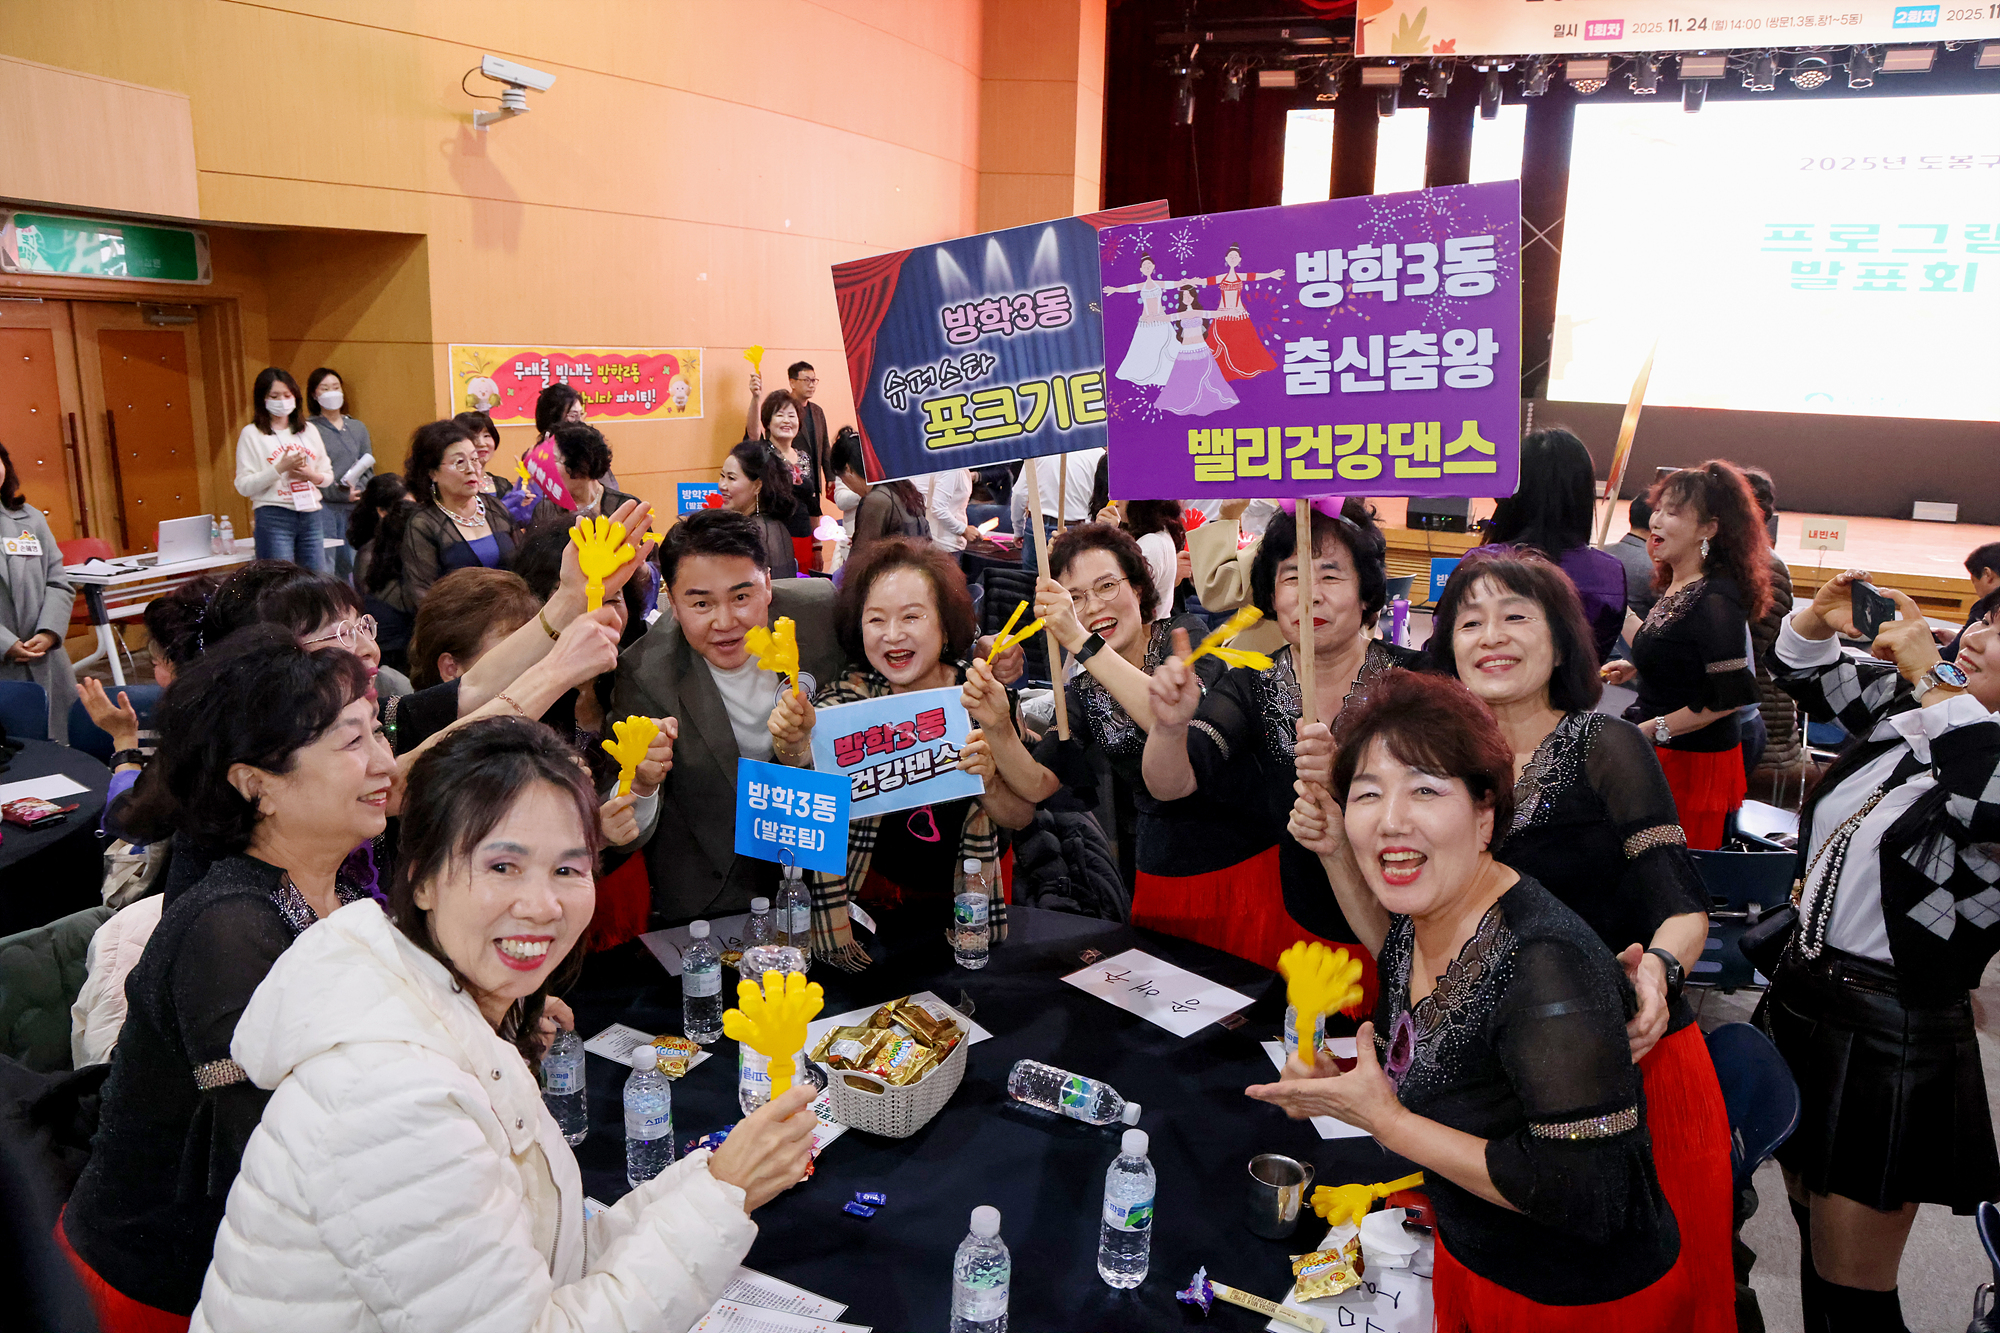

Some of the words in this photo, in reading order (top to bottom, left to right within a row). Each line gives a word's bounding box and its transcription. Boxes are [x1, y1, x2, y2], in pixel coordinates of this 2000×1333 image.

[1553, 23, 1578, 38] 일시
[1586, 22, 1621, 38] 1회차
[1632, 22, 1665, 34] 2025.
[1730, 18, 1761, 31] 14:00
[1895, 10, 1937, 24] 2회차
[1946, 9, 1985, 22] 2025.
[1799, 156, 1907, 171] 2025년
[1917, 154, 2000, 170] 도봉구
[1295, 235, 1498, 308] 방학3동
[1790, 260, 1979, 292] 발표회
[942, 286, 1072, 344] 방학3동
[514, 358, 551, 388] 무대를
[1283, 328, 1499, 395] 춤신춤왕
[616, 388, 657, 409] 파이팅!
[884, 353, 995, 410] 슈퍼스타
[1188, 420, 1497, 481] 밸리건강댄스
[1808, 529, 1839, 540] 내빈석
[833, 707, 947, 767] 방학3동
[850, 743, 962, 802] 건강댄스
[748, 781, 837, 823] 방학3동
[753, 817, 825, 852] (발표팀)
[890, 1039, 912, 1068] Happy
[644, 1113, 669, 1127] 스파클
